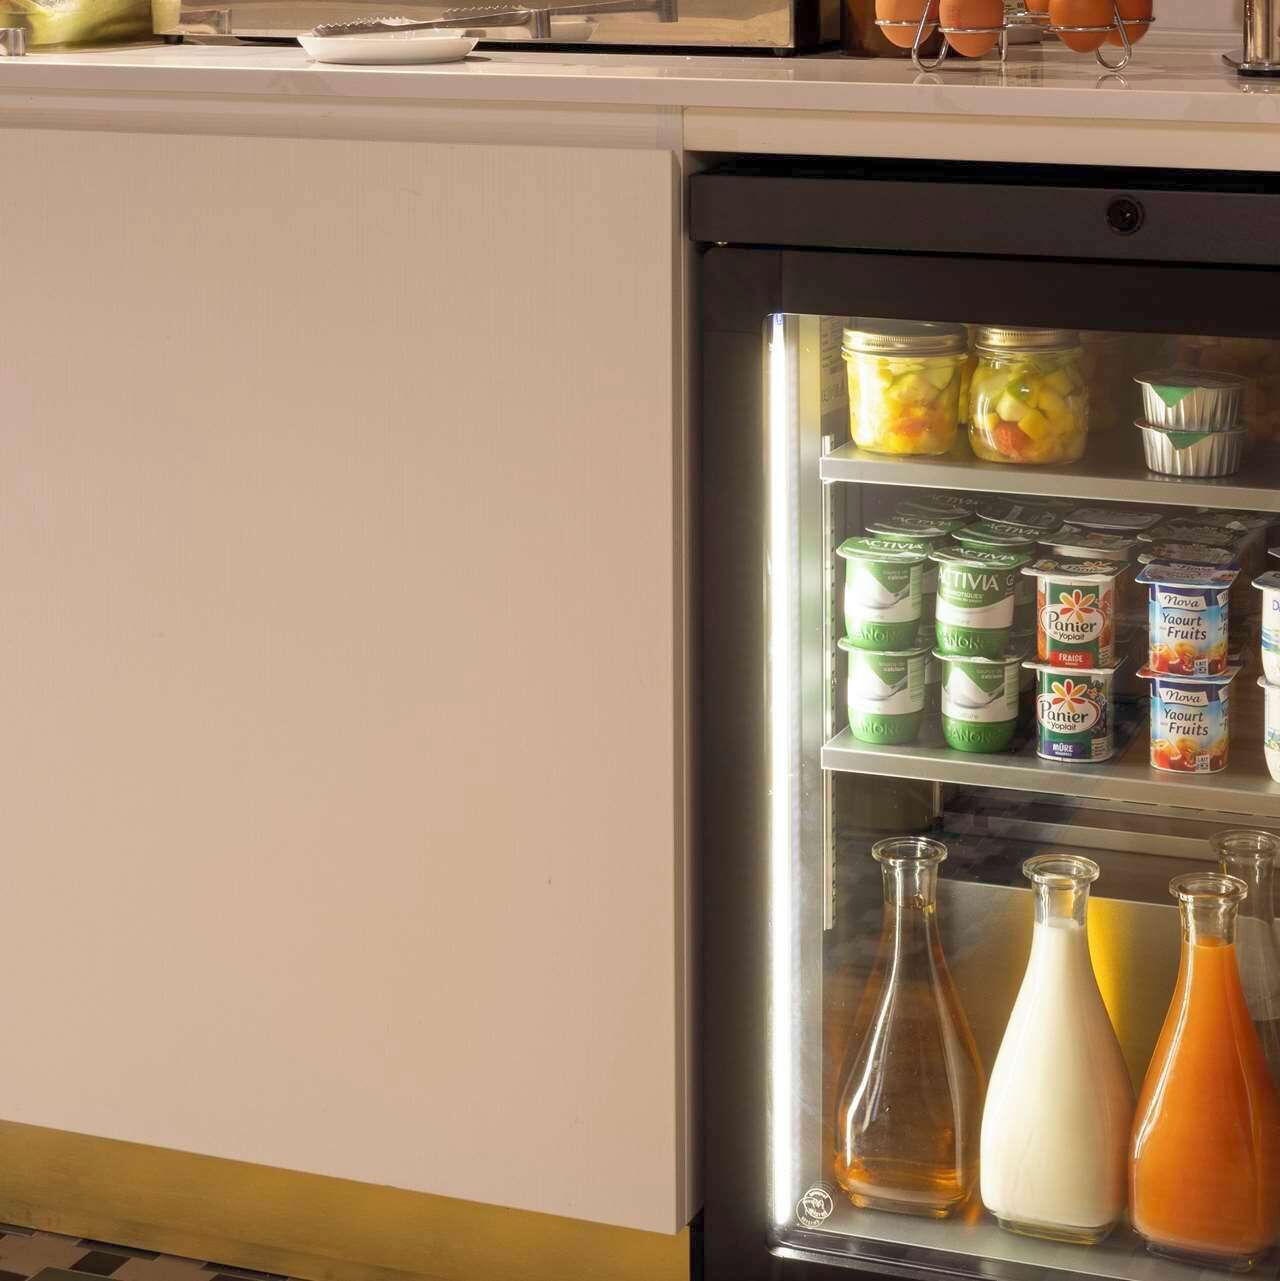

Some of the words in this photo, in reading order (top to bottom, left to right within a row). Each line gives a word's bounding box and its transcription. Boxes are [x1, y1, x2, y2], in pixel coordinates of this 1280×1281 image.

[857, 538, 924, 550] ACTIVIA
[951, 547, 1017, 562] ACTIVIA
[1164, 594, 1200, 609] Nova
[1047, 610, 1097, 635] Panier
[1162, 612, 1202, 627] Yaourt
[1058, 631, 1085, 642] Yoplait
[1167, 625, 1207, 641] Fruits
[1058, 652, 1084, 664] FRAISE
[1165, 690, 1202, 704] Nova
[1039, 700, 1089, 725] Panier
[1163, 708, 1204, 723] Yaourt
[1051, 721, 1077, 732] Yoplait
[1168, 722, 1209, 737] Fruits
[1051, 741, 1074, 753] MÛRE
